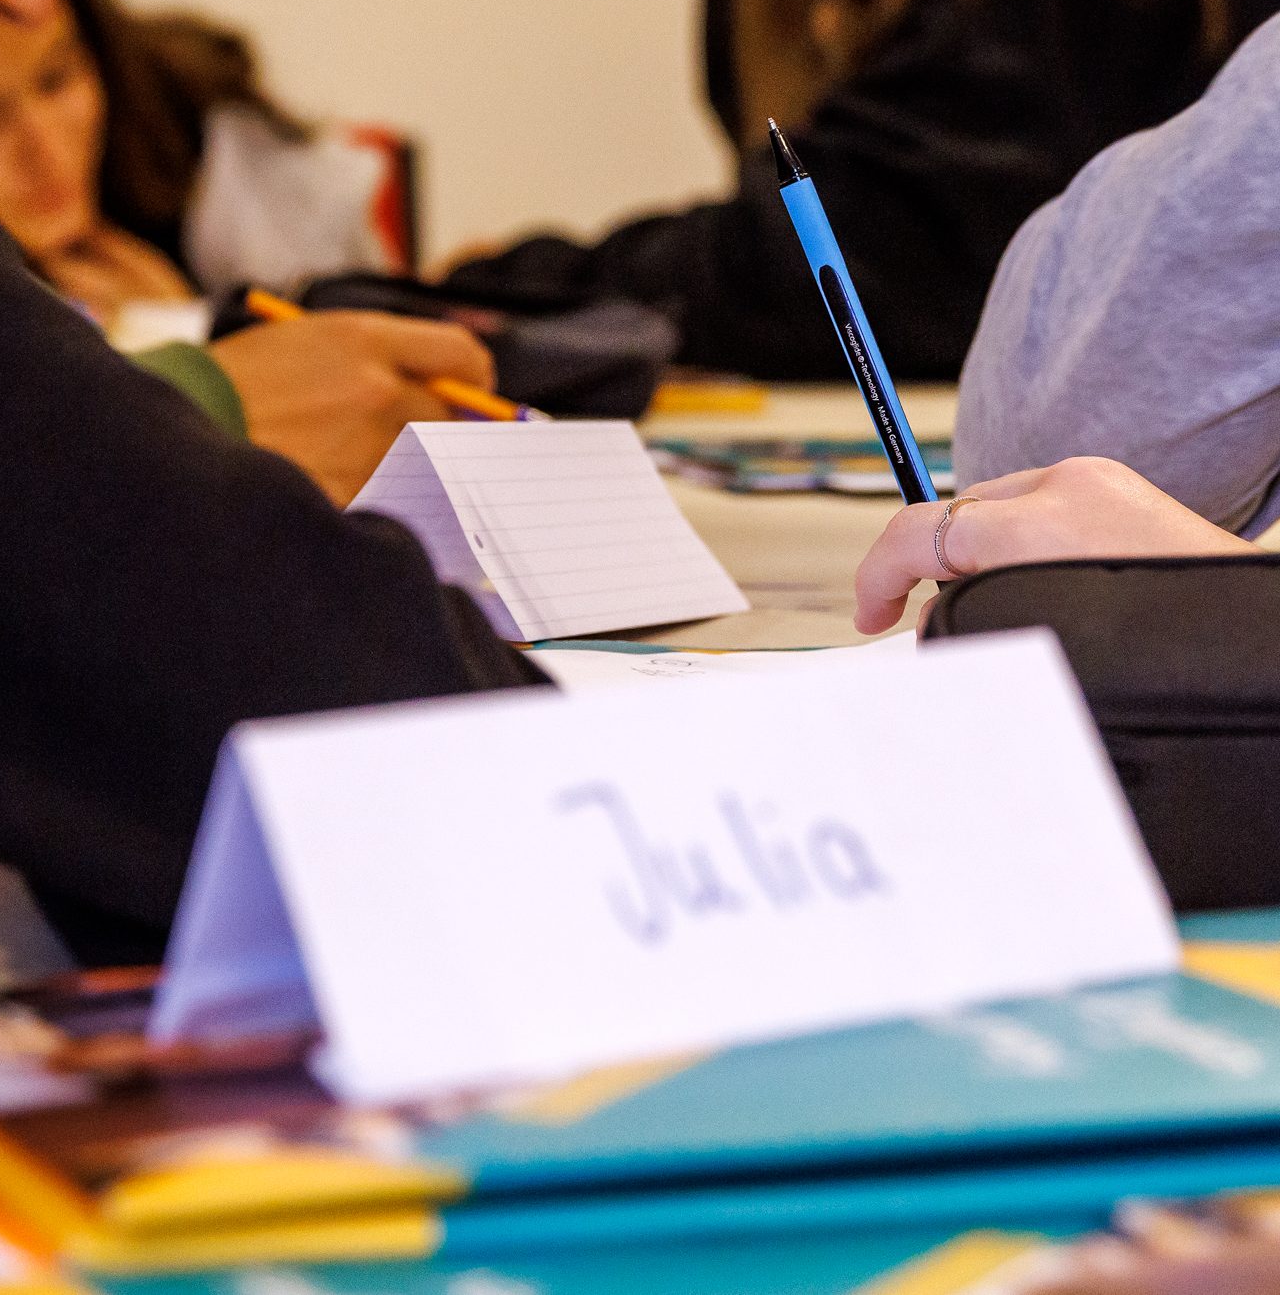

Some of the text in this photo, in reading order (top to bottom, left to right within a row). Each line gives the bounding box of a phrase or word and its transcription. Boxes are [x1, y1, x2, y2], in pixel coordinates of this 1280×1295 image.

[877, 405, 889, 426] Made
[885, 425, 893, 434] in
[889, 434, 904, 464] Germany
[551, 780, 896, 949] Julia
